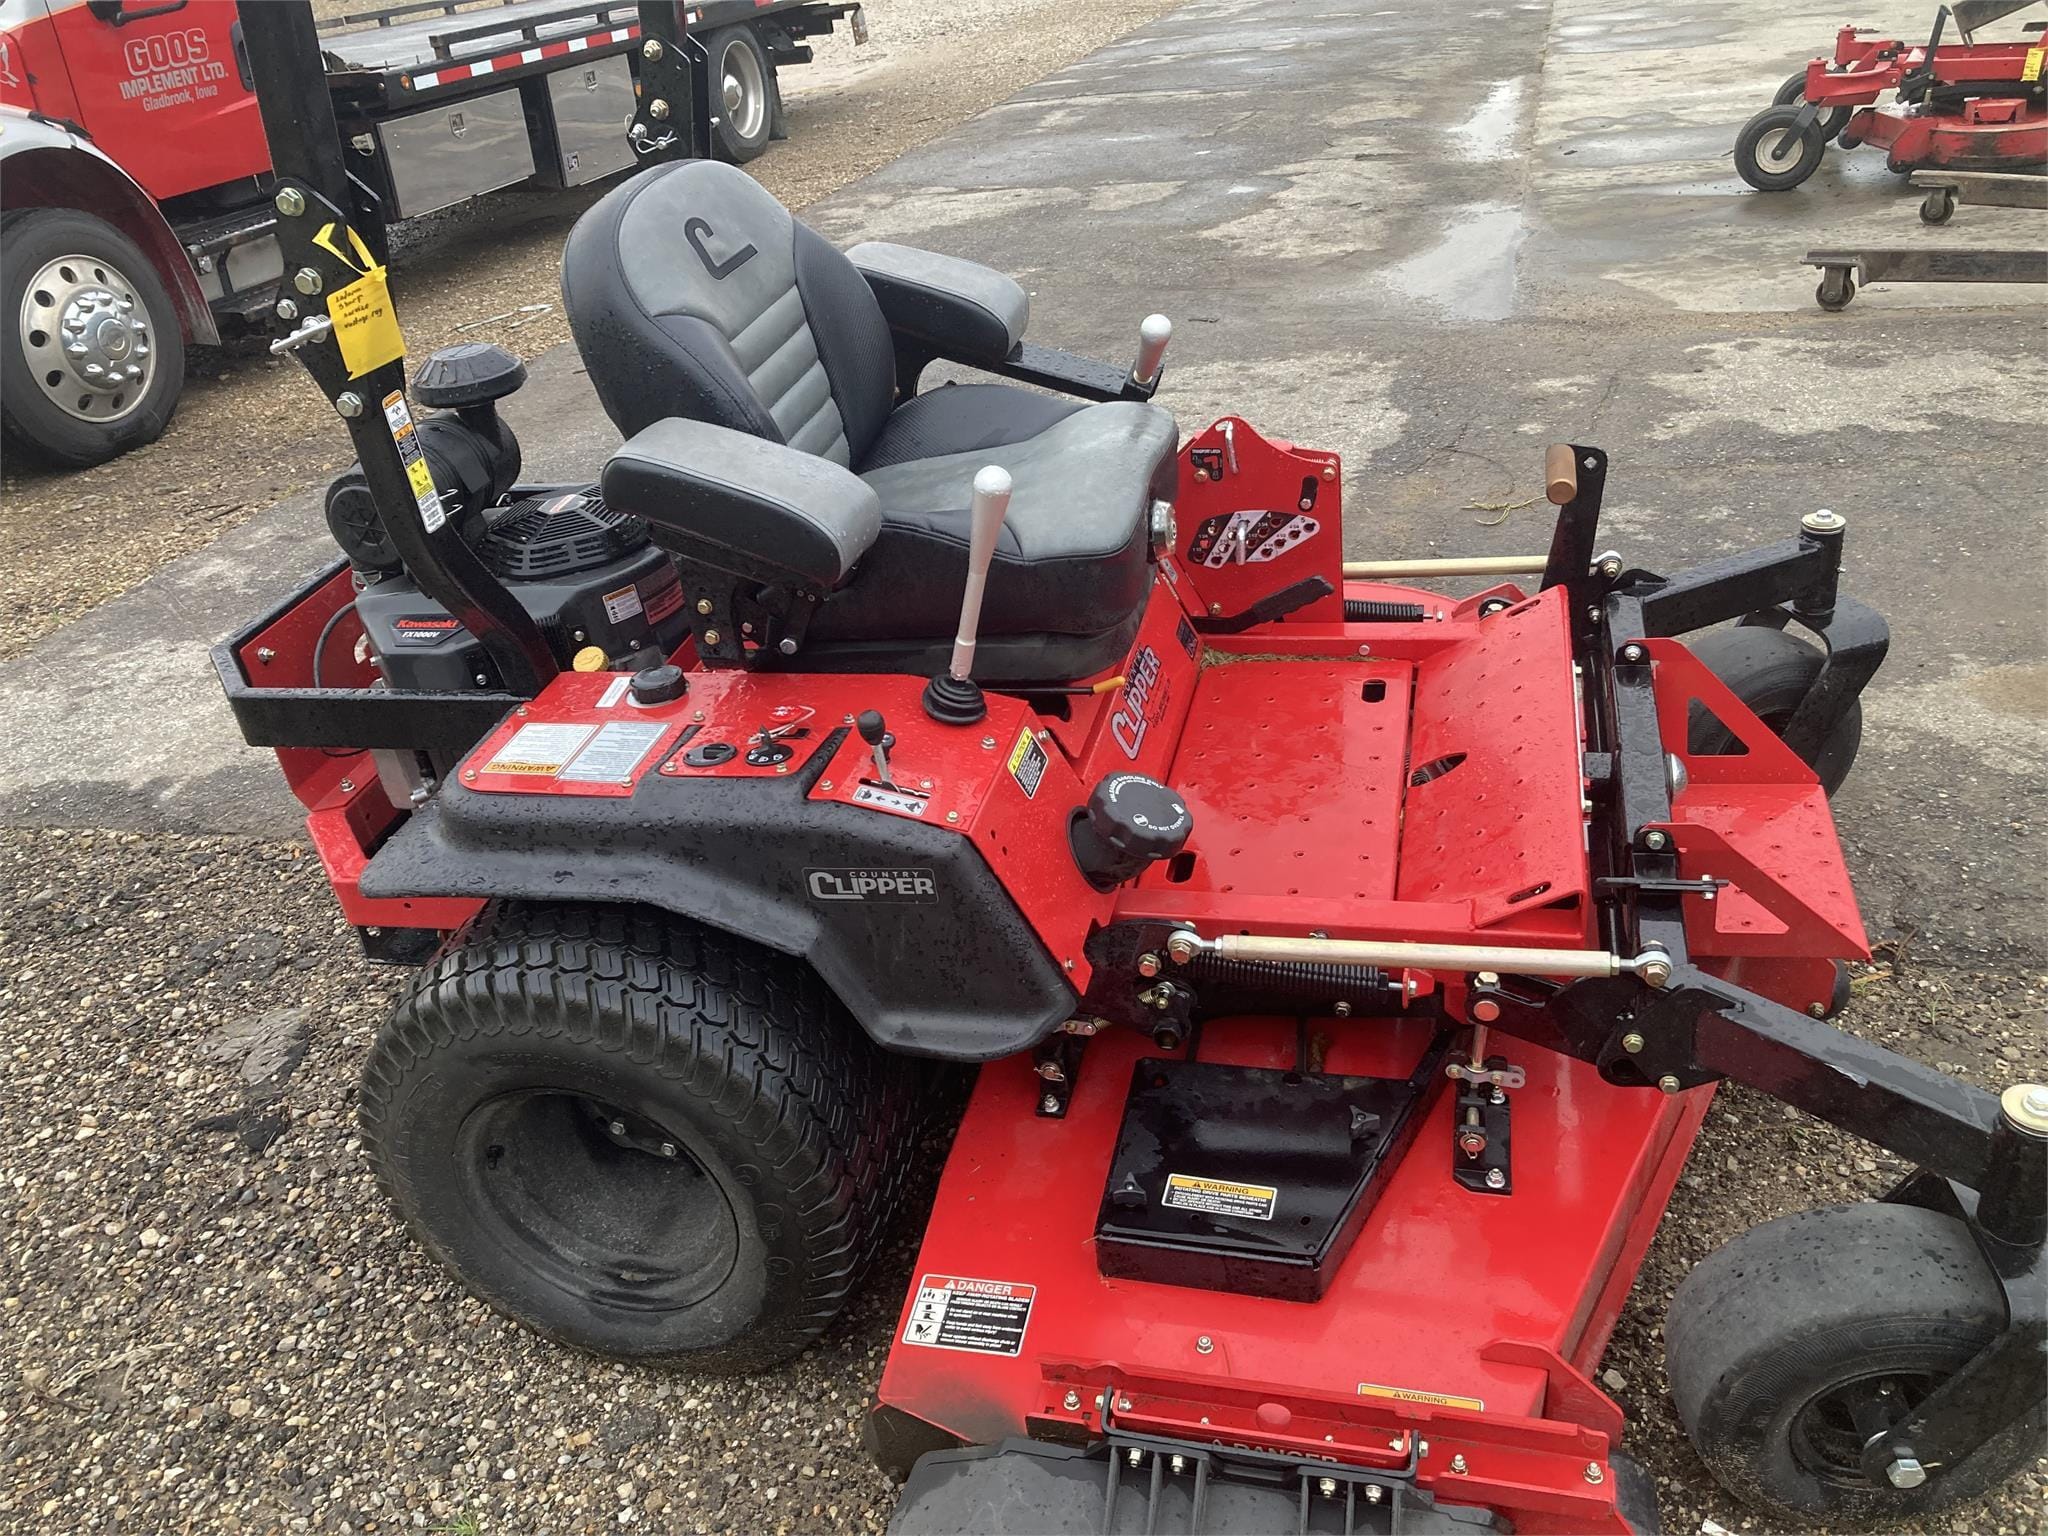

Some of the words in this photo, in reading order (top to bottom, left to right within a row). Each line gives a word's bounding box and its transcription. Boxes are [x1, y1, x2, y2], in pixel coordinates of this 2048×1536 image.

[124, 28, 209, 76] GOOS
[119, 67, 198, 99] IMPLEMENT
[201, 62, 229, 81] LTD.
[143, 89, 195, 111] Gladbrook,
[195, 85, 218, 99] Iowa
[396, 619, 459, 628] Kawasaki
[1111, 645, 1161, 760] CLIPPER
[809, 872, 935, 900] CLIPPER
[1204, 1182, 1249, 1195] WARNING
[957, 1281, 1012, 1296] DANGER
[1402, 1392, 1447, 1404] WARNING
